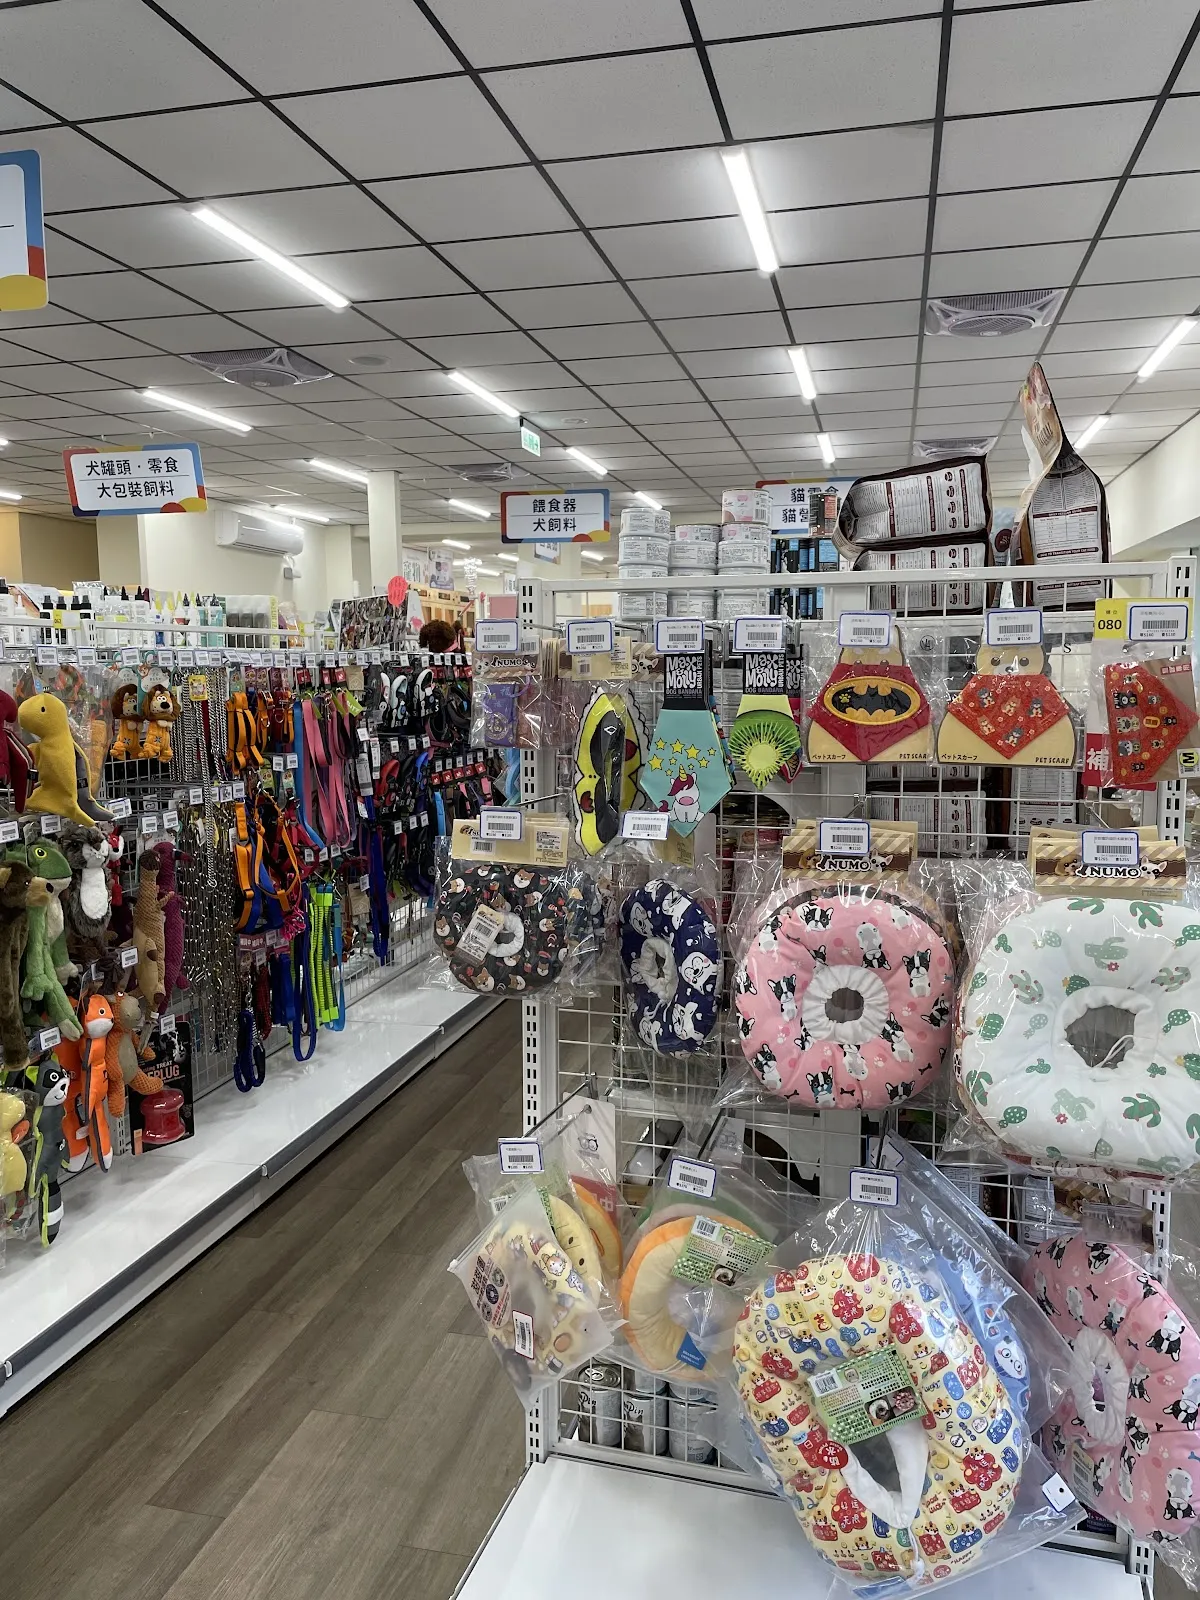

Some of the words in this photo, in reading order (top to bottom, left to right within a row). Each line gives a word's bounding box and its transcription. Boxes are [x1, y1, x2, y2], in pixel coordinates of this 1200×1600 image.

[97, 480, 174, 498] 大包裝飼料
[532, 498, 577, 513] 餵食器
[532, 517, 577, 532] 犬飼料
[1098, 620, 1122, 630] 080
[1087, 748, 1109, 770] 補
[156, 1060, 172, 1070] TREAT
